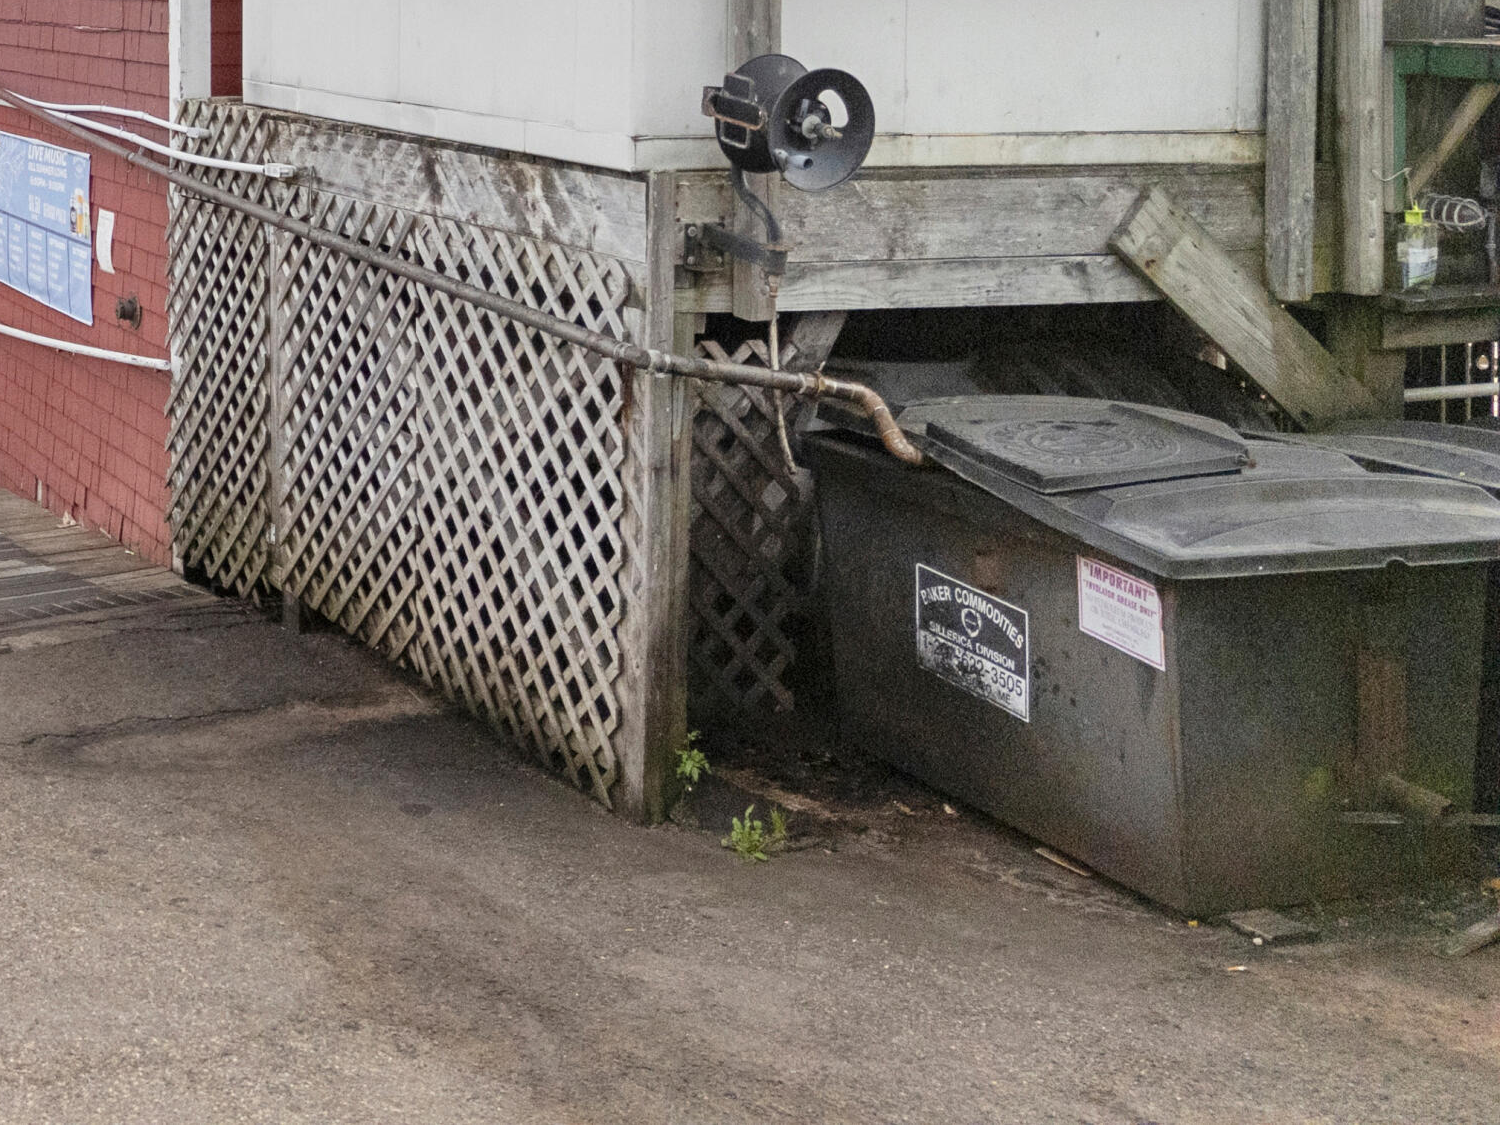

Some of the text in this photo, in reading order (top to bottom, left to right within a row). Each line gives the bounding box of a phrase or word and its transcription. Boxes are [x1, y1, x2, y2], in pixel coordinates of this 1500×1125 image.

[920, 586, 1024, 649] BAKER COMMODITIES
[975, 643, 1015, 671] DIVISION
